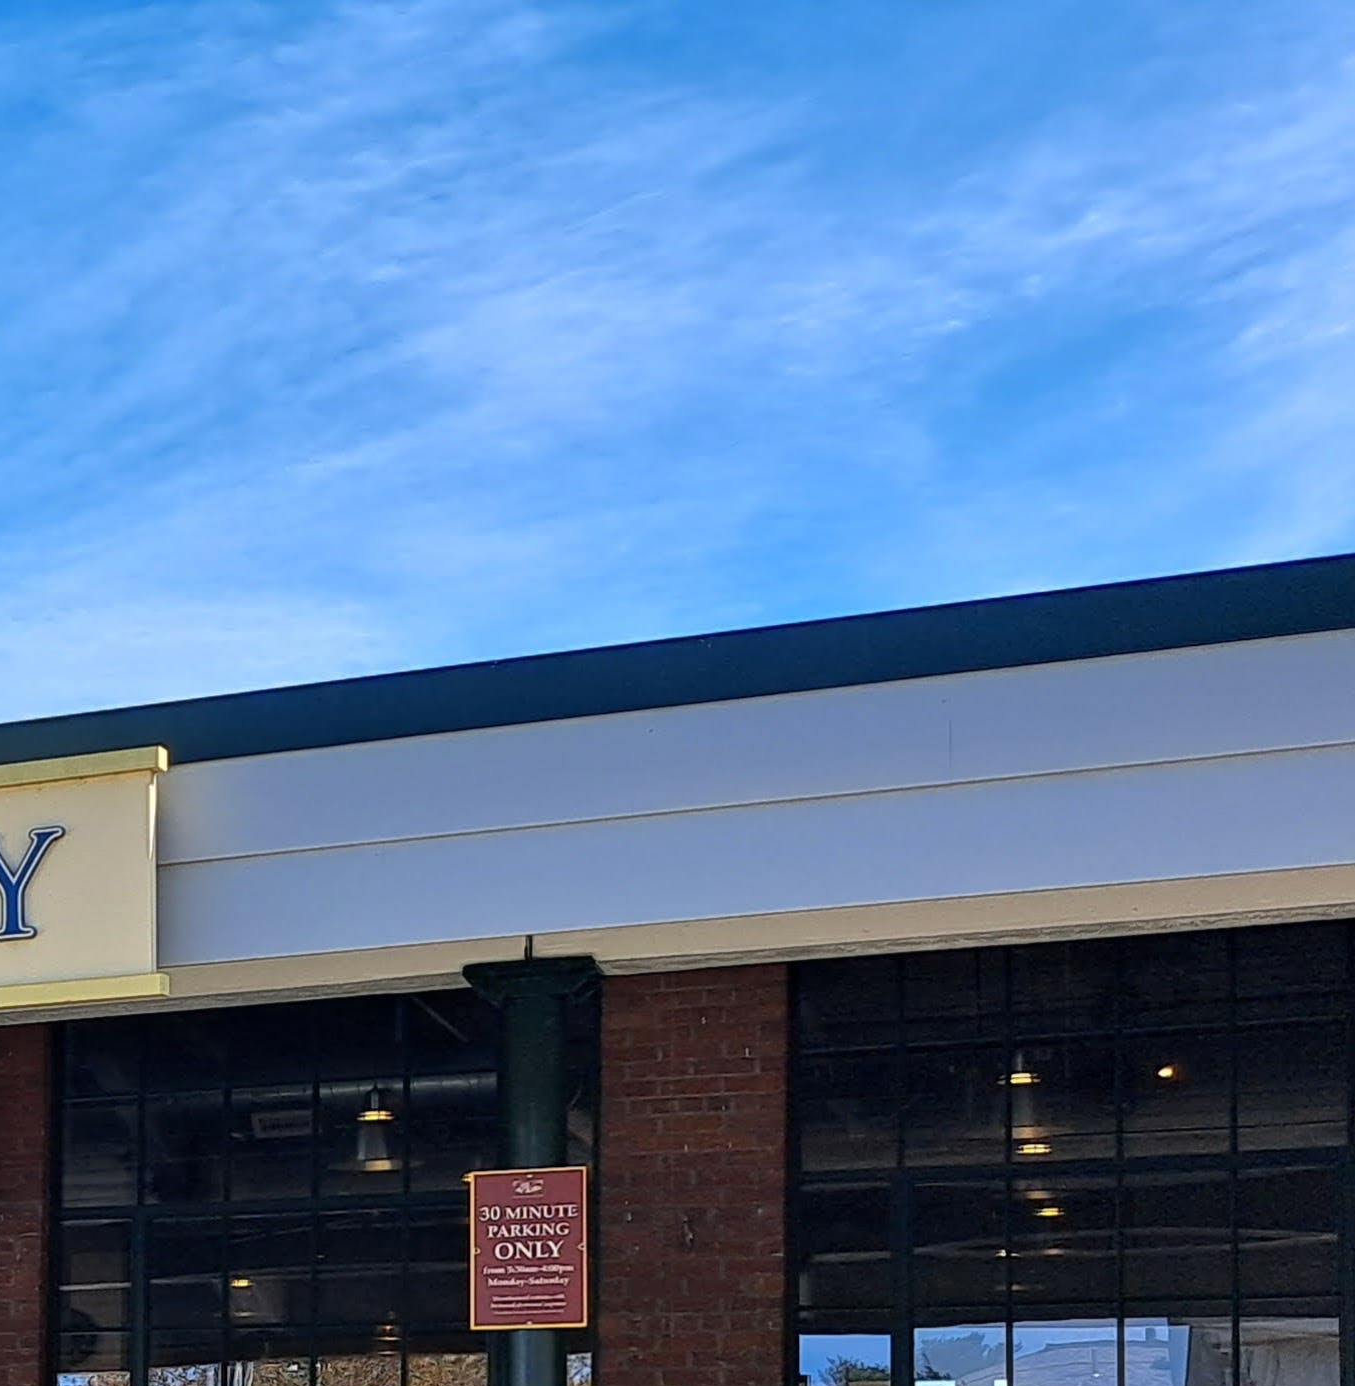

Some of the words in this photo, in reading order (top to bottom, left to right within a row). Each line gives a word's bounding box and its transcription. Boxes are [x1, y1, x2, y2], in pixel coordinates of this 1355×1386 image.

[478, 1206, 501, 1221] 30
[505, 1204, 579, 1220] MINUTE
[487, 1222, 570, 1238] PARKING
[494, 1240, 565, 1260] ONLY
